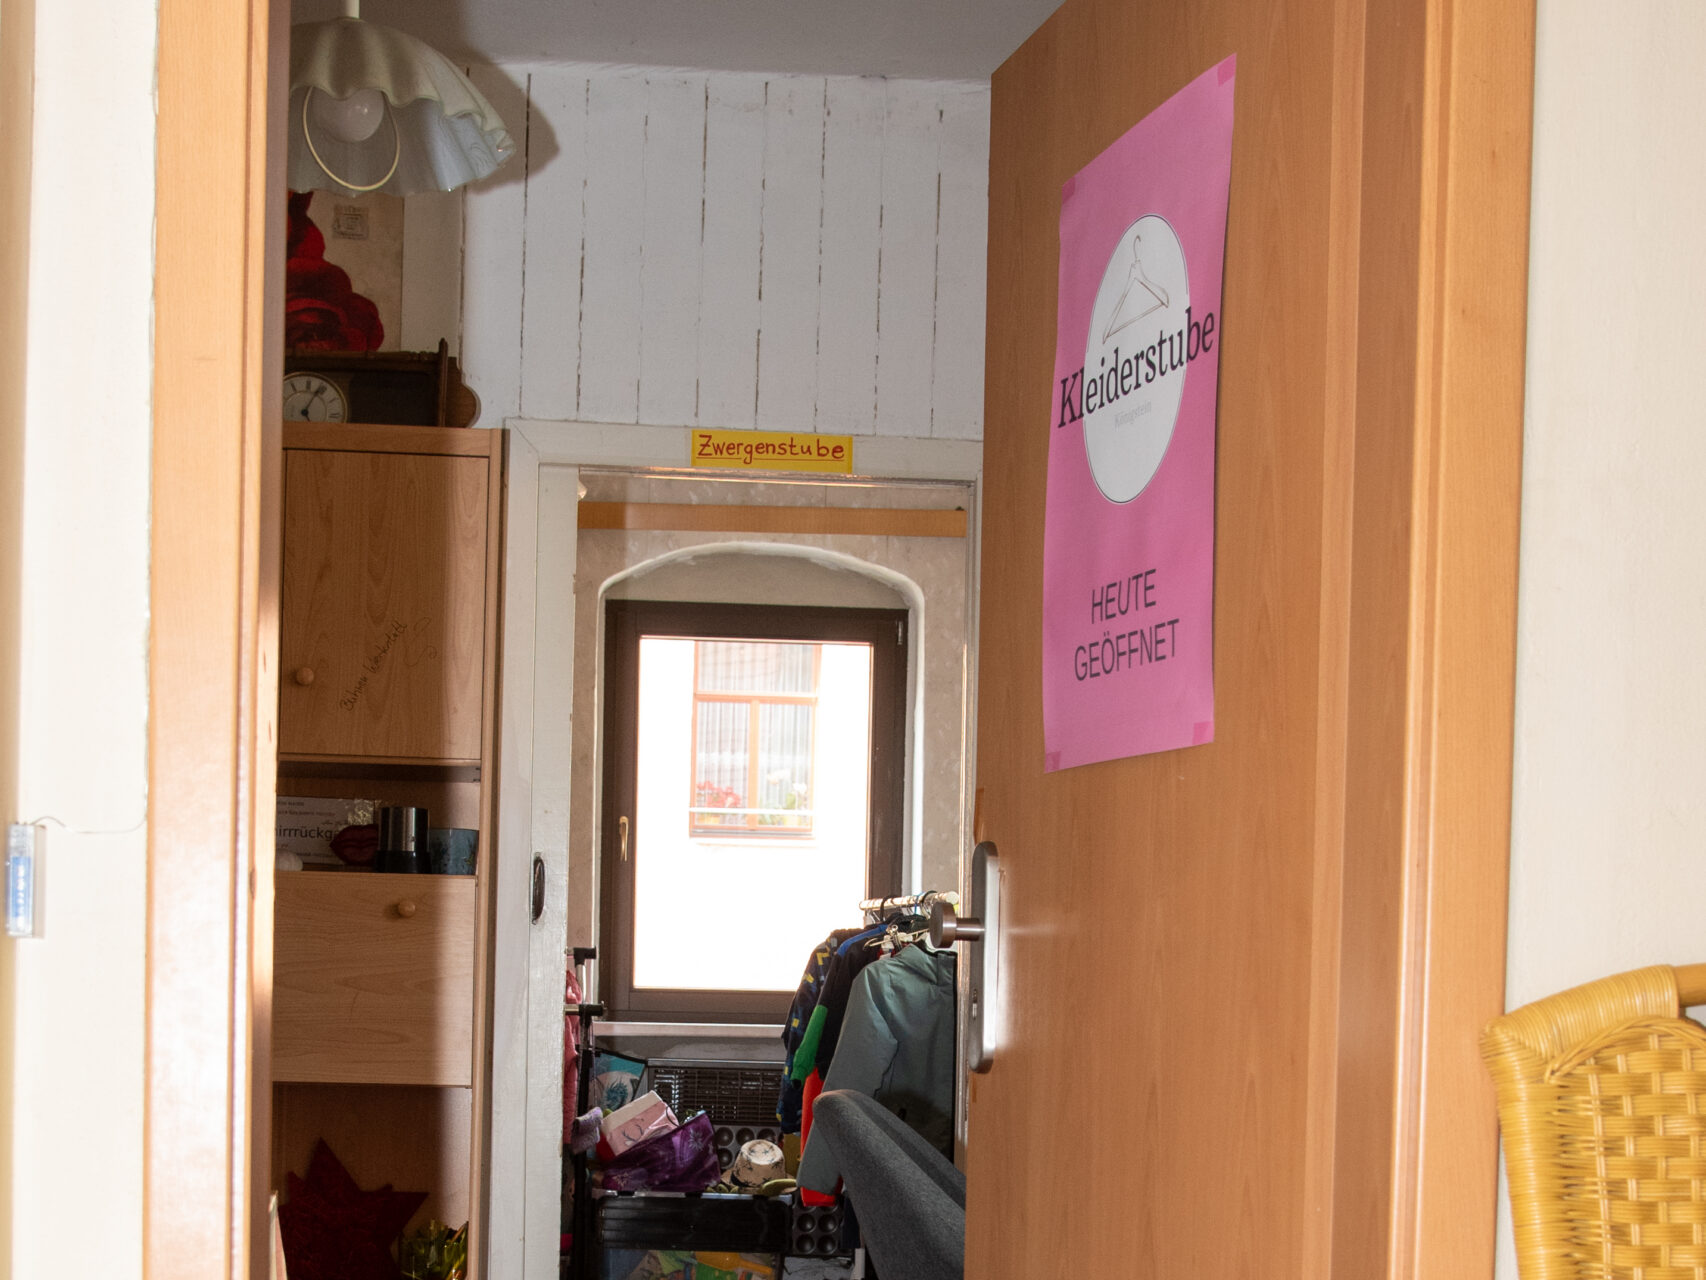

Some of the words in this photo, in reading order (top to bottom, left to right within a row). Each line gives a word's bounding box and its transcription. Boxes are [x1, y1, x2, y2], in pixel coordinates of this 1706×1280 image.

[1058, 306, 1215, 428] Kleiderstube
[698, 434, 845, 465] Zwergenstube
[1091, 568, 1157, 624] HEUTE
[1074, 618, 1180, 681] GEÖFFNET
